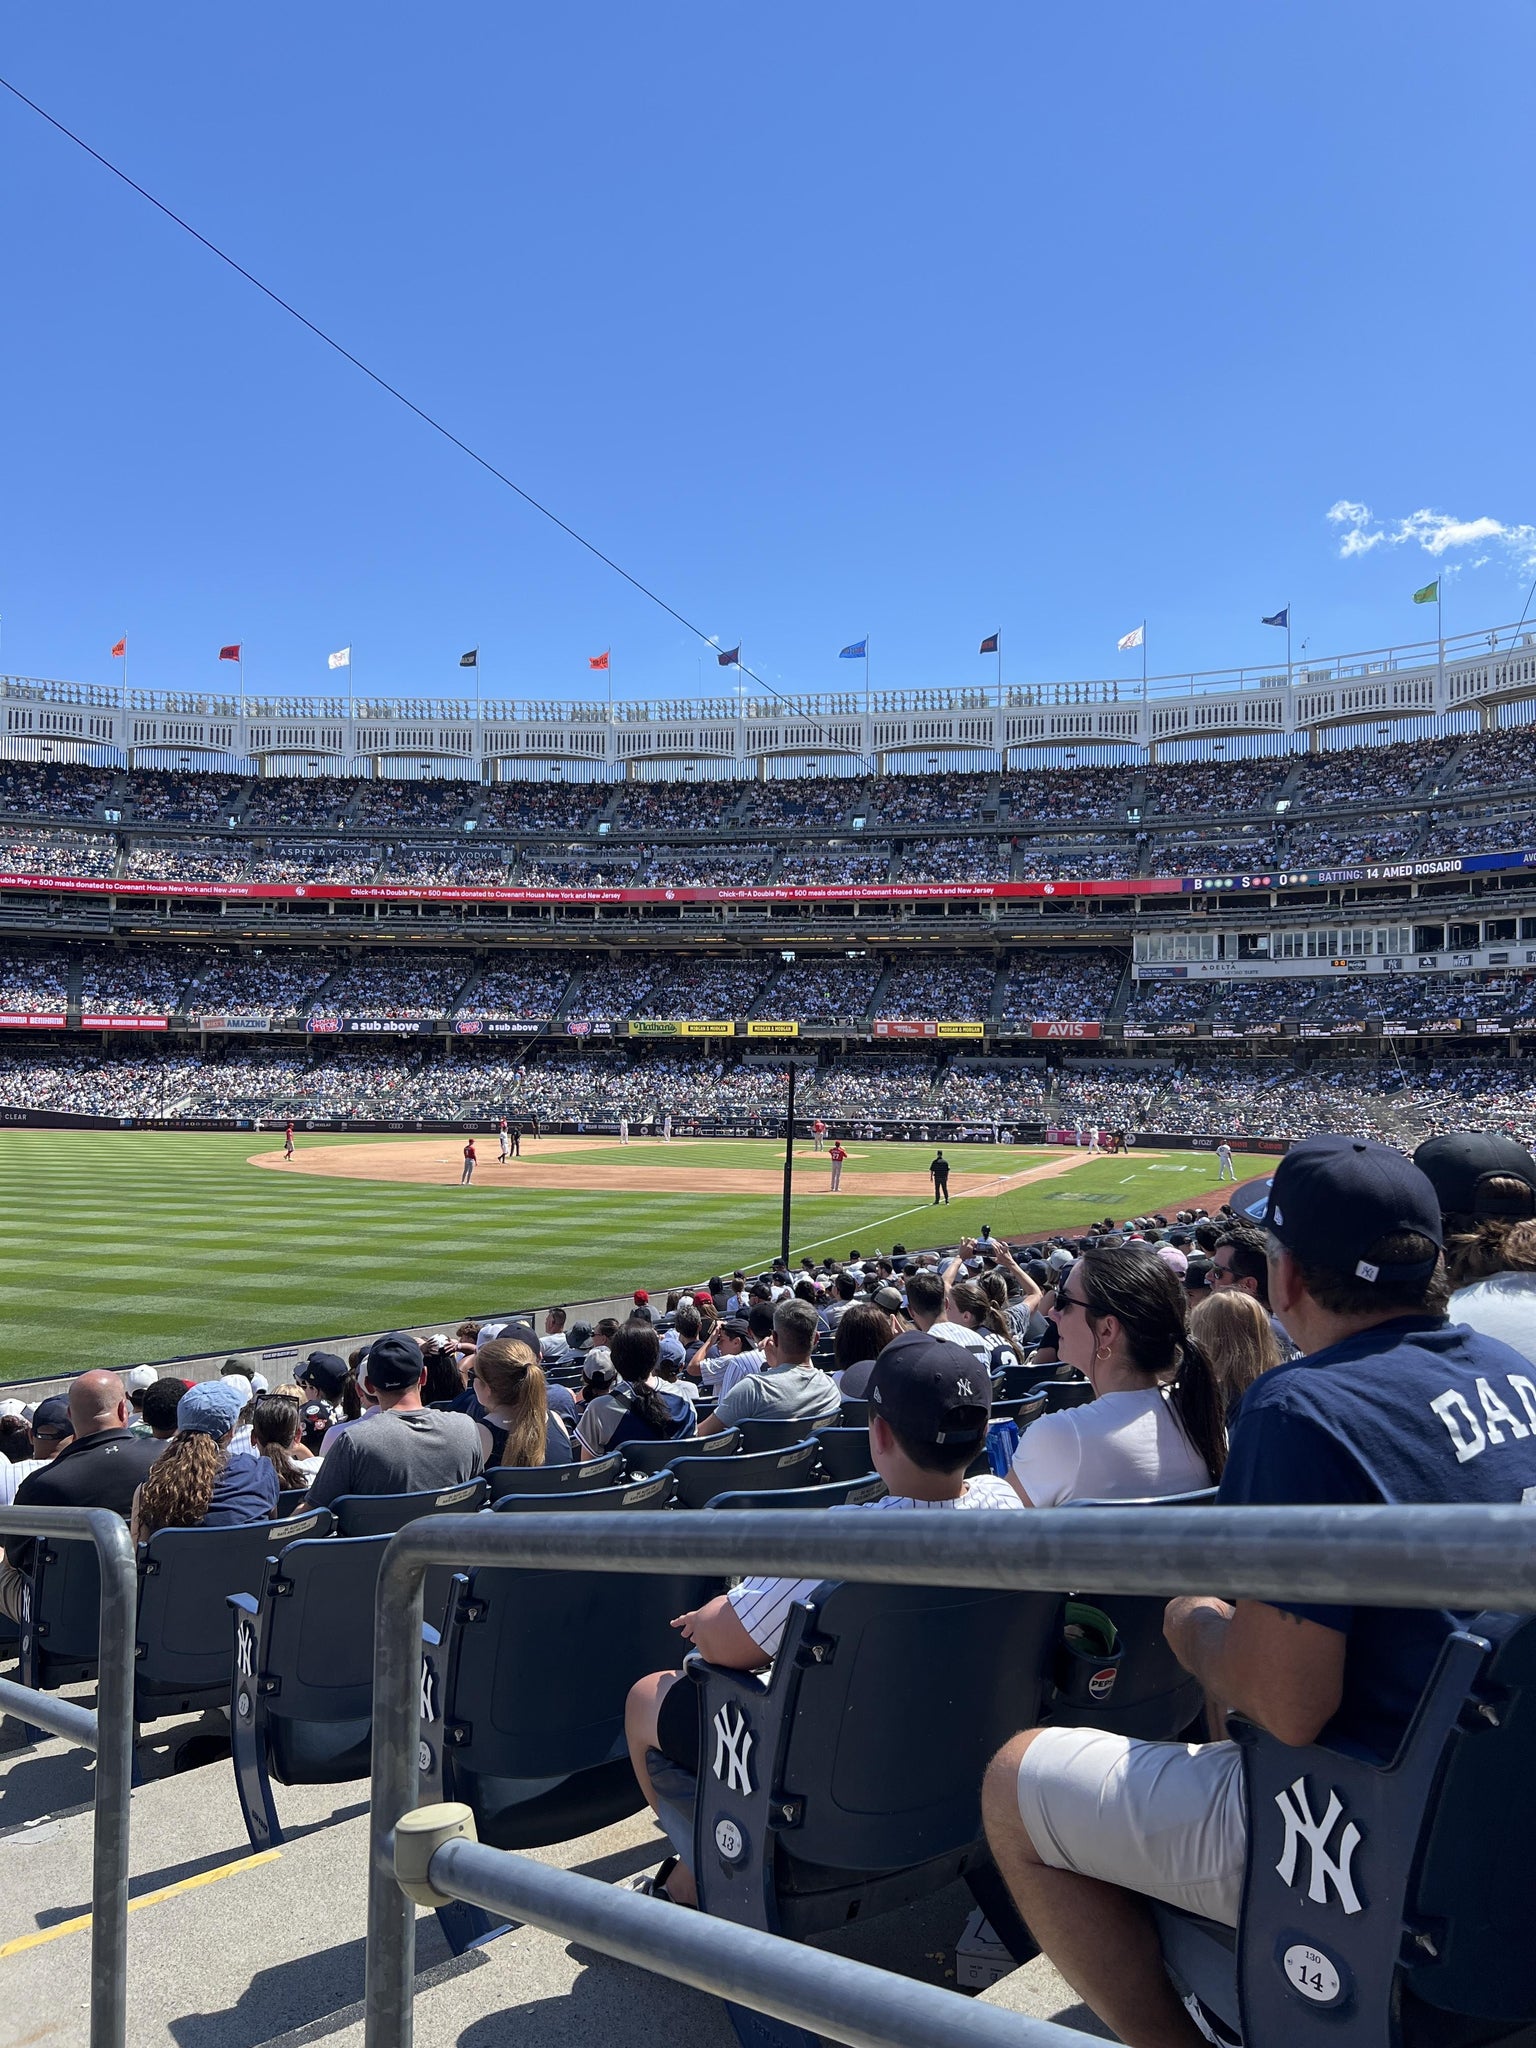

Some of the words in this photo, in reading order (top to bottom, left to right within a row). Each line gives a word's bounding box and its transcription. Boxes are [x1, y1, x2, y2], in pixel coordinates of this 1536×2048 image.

[280, 848, 315, 856] ASPEN
[328, 849, 364, 857] VODKA
[1318, 869, 1363, 882] BATTING:
[1366, 868, 1379, 879] 14
[1383, 865, 1413, 878] AMED
[1415, 859, 1462, 876] ROSARIO
[17, 877, 32, 887] Play
[39, 879, 54, 887] 500
[55, 879, 75, 888] meals
[76, 880, 105, 890] donated
[114, 882, 146, 891] Covenant
[147, 884, 168, 892] House
[184, 885, 199, 893] York
[199, 886, 212, 894] and
[228, 887, 248, 895] Jersey
[1194, 878, 1203, 890] B
[1242, 876, 1250, 888] S
[350, 888, 386, 897] Chick-fil-A
[386, 889, 408, 897] Double
[409, 889, 422, 898] Play
[461, 890, 486, 898] donated
[525, 891, 545, 899] House
[575, 891, 587, 899] and
[601, 892, 621, 900] Jersey
[718, 890, 752, 898] Chick-fil-A
[753, 890, 775, 898] Double
[775, 889, 788, 899] Play
[808, 889, 826, 897] meals
[827, 888, 853, 896] donated
[861, 888, 892, 896] Covenant
[913, 887, 928, 895] New
[929, 887, 943, 895] York
[972, 886, 994, 895] Jersey
[226, 1019, 267, 1028] AMAZING
[351, 1022, 359, 1030] a
[360, 1020, 381, 1031] sub
[383, 1021, 420, 1031] above
[495, 1023, 511, 1031] sub
[511, 1023, 538, 1032] above
[633, 1021, 677, 1034] Nathan's
[1047, 1024, 1084, 1036] AVIS
[1198, 1138, 1213, 1146] razr
[1258, 1142, 1283, 1150] Canon
[956, 1378, 973, 1396] NY
[237, 1621, 252, 1677] NY
[712, 1703, 752, 1796] NY
[721, 1833, 735, 1851] 13
[1274, 1776, 1362, 1915] NY
[1304, 1950, 1322, 1964] 130
[1298, 1965, 1324, 1993] 14
